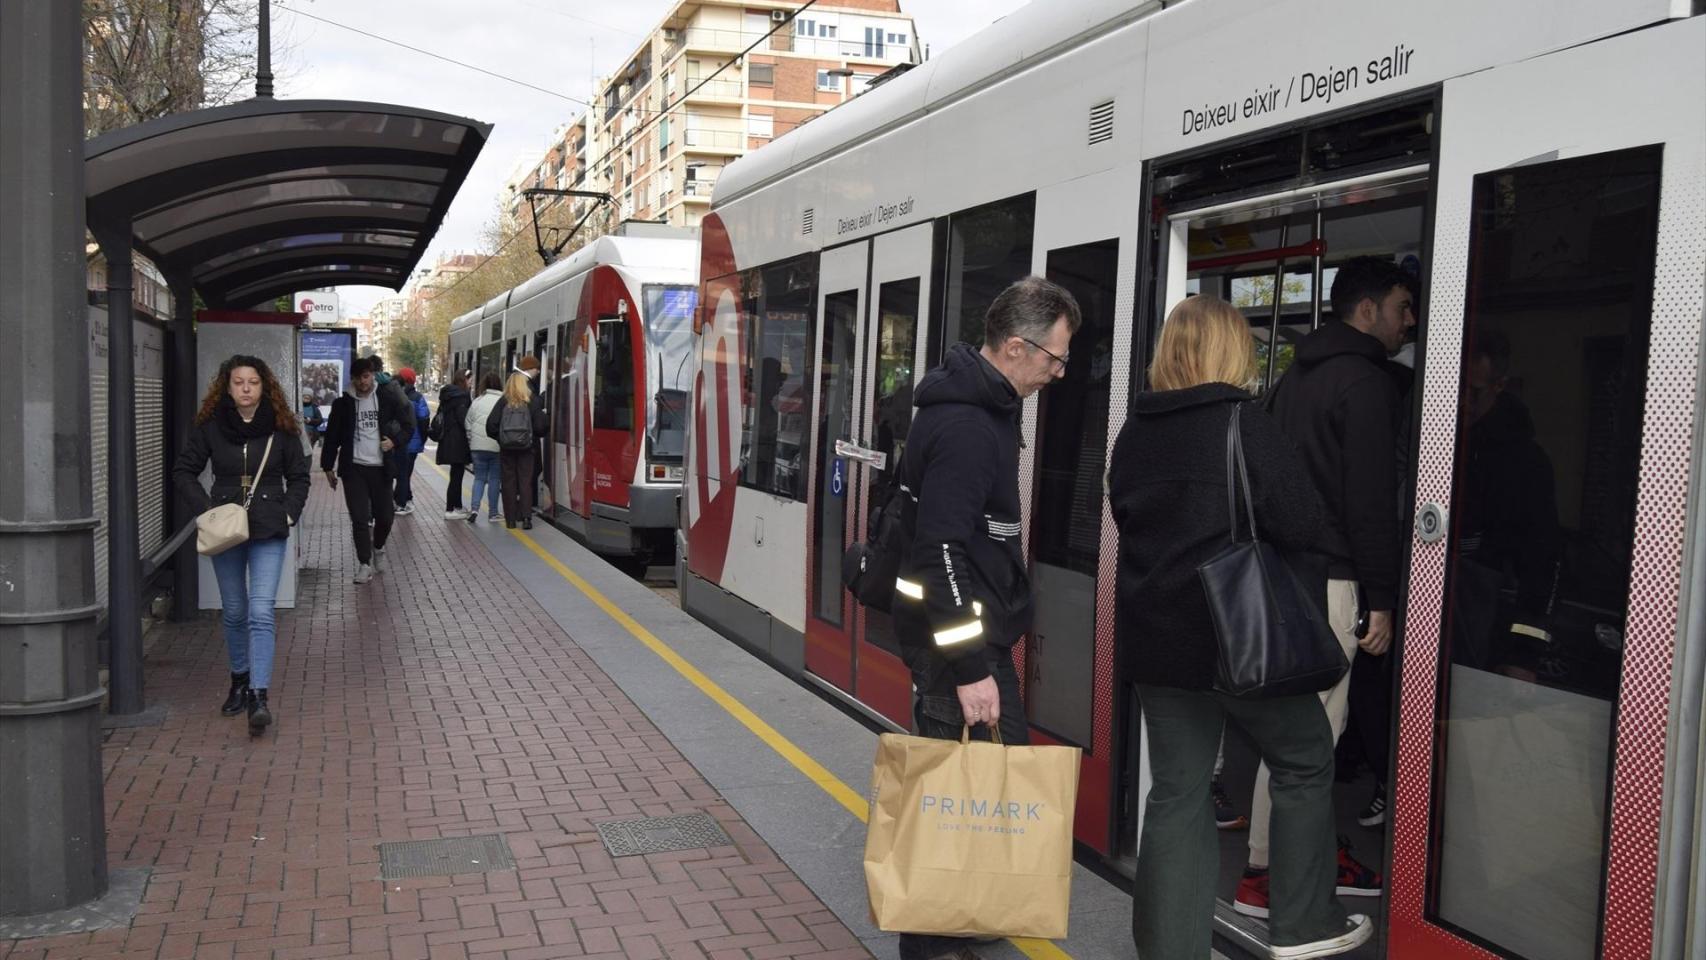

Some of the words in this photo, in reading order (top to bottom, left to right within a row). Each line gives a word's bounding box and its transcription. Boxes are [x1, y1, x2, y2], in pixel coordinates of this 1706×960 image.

[1182, 102, 1237, 135] Deixeu
[1243, 84, 1280, 118] eixir
[1285, 76, 1295, 108] /
[1300, 66, 1358, 103] Dejen
[1366, 44, 1414, 84] salir
[837, 217, 858, 235] Deixeu
[859, 210, 873, 229] eixir
[878, 203, 898, 224] Dejen
[899, 195, 914, 216] salir
[305, 303, 334, 313] metro
[922, 795, 1041, 820] PRIMARK
[938, 824, 960, 832] LOVE
[967, 825, 983, 833] THE
[988, 826, 1025, 835] FEELING
